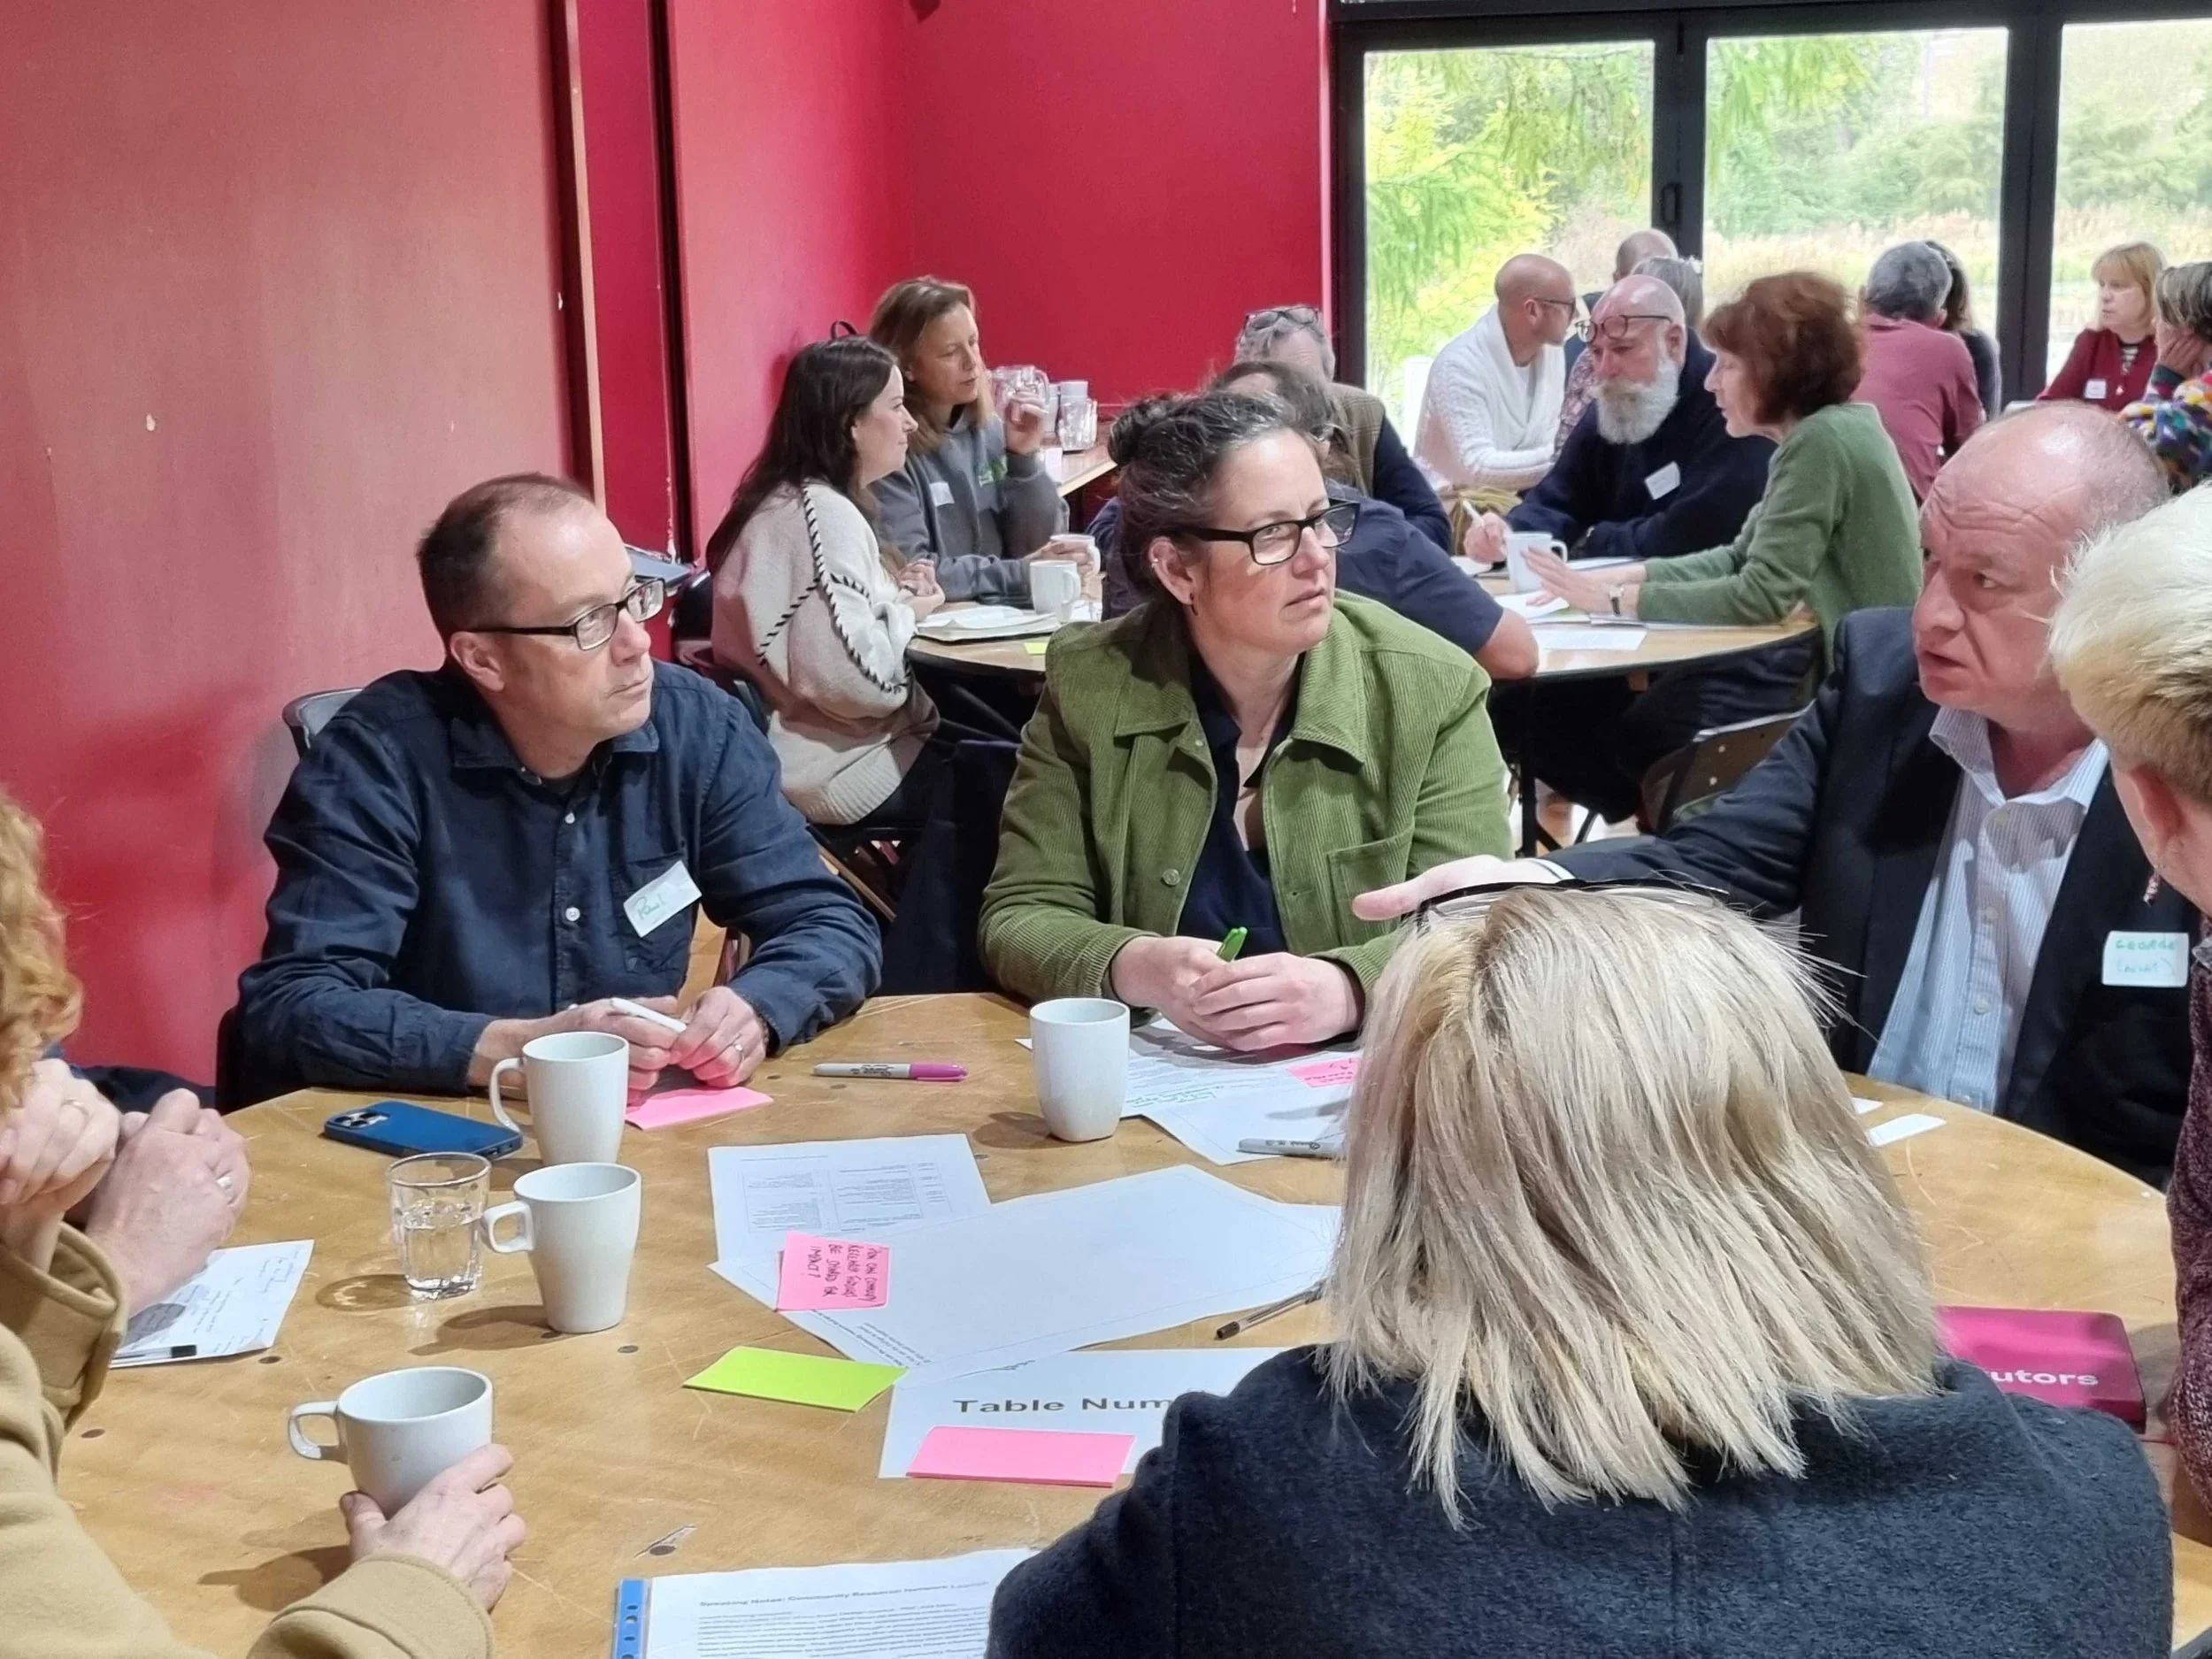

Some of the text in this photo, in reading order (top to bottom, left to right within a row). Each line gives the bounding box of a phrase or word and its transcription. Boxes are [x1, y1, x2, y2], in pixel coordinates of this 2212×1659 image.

[1990, 1370, 2099, 1386] utors
[952, 1397, 1172, 1413] Table Num
